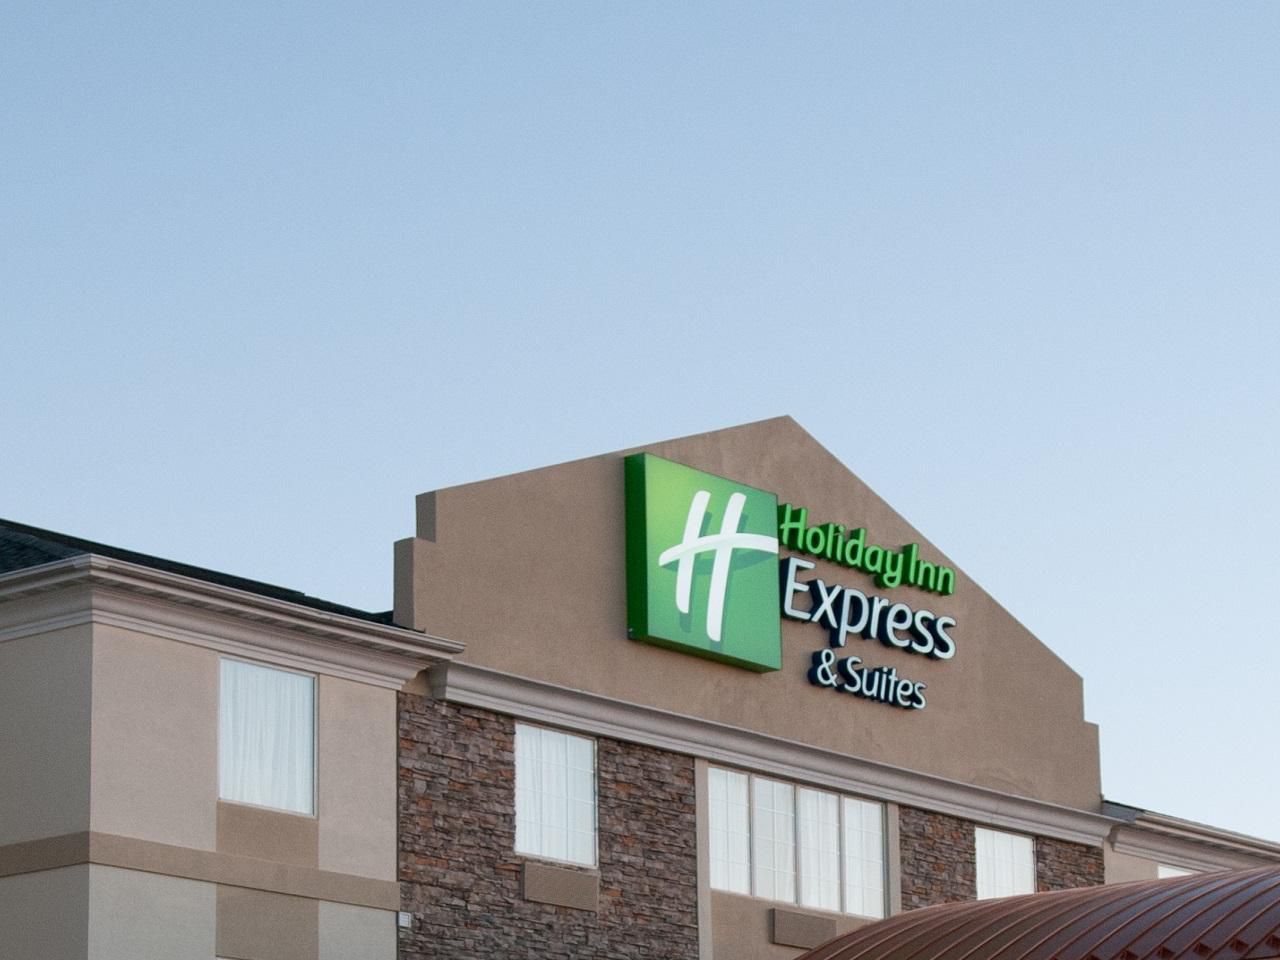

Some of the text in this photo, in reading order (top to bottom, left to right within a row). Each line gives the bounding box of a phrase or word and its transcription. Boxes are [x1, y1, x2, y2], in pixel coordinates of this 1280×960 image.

[778, 503, 955, 596] Holiday Inn
[781, 556, 957, 660] Express
[810, 648, 927, 710] & Suites
